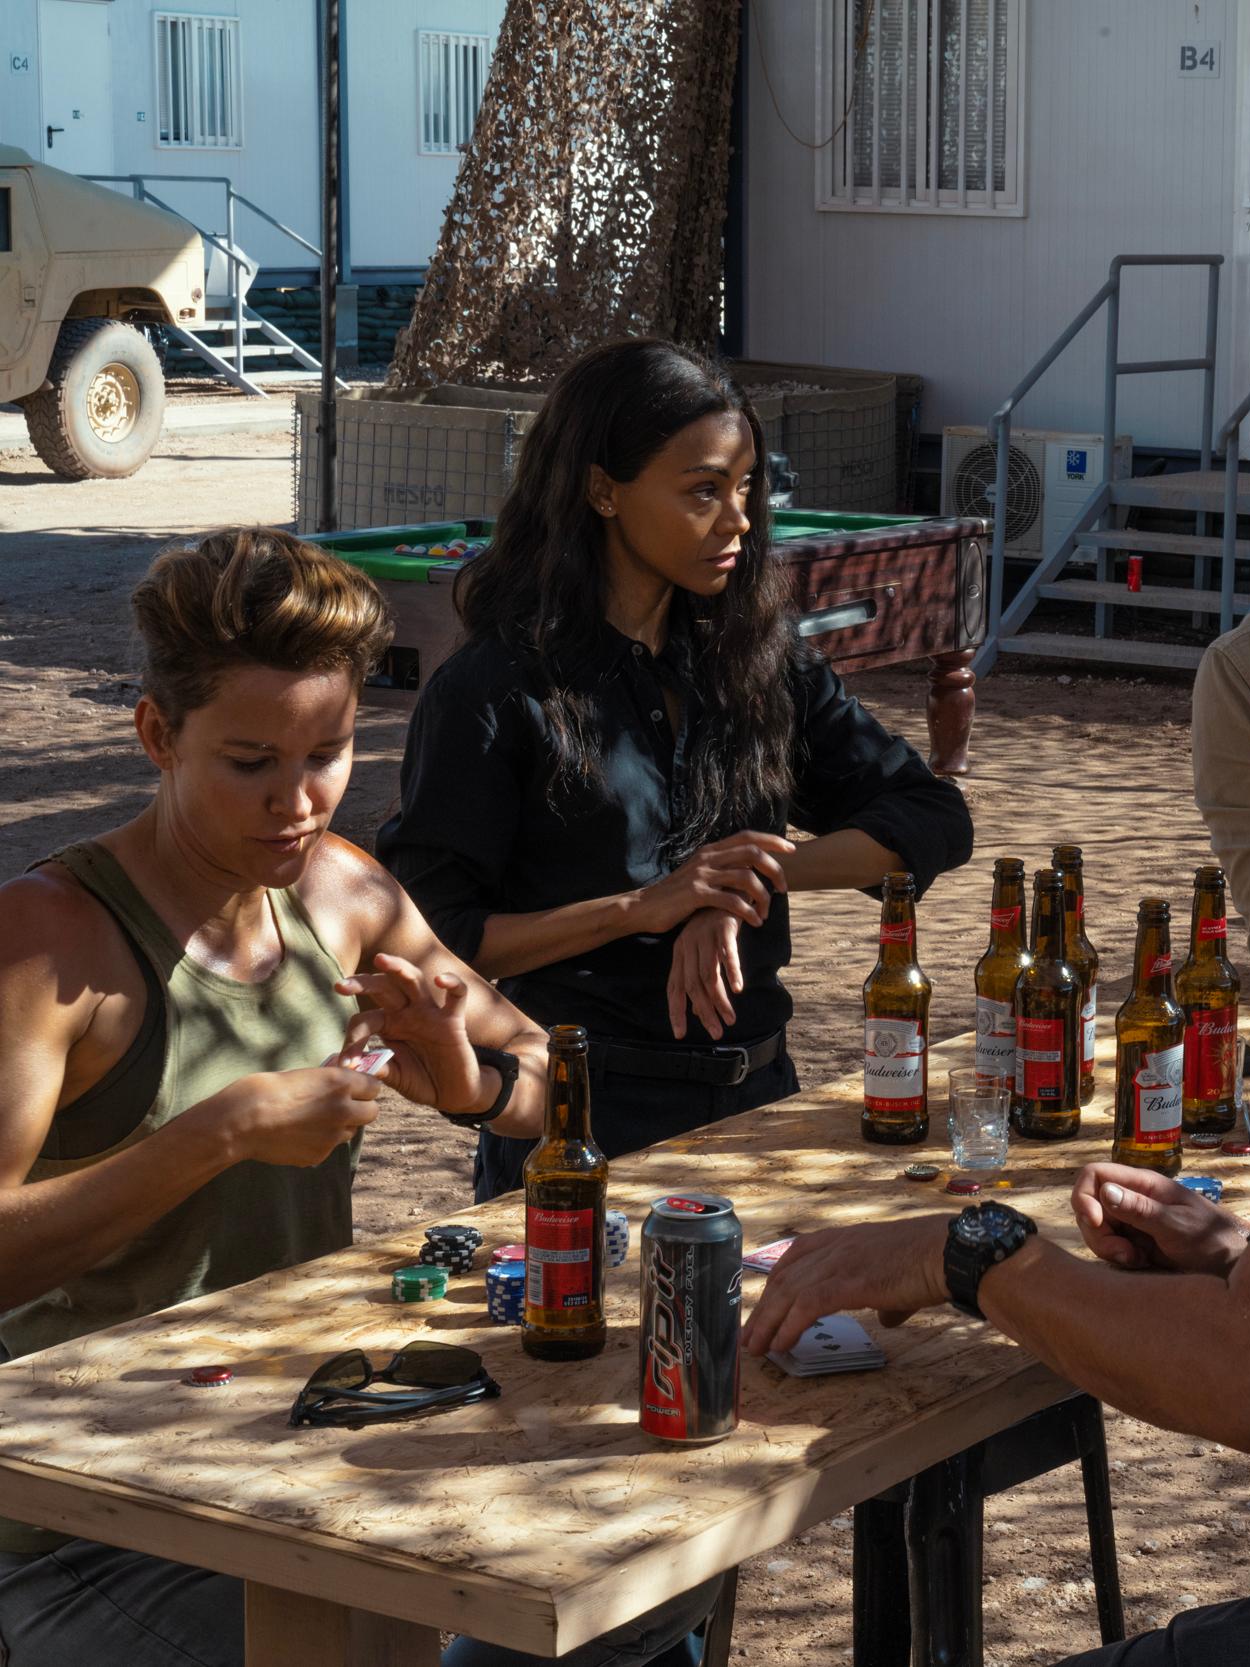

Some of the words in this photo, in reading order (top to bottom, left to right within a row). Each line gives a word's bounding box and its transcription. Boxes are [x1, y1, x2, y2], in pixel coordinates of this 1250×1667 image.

[12, 56, 29, 71] C4
[1180, 46, 1215, 71] B4
[534, 1210, 580, 1224] Budweiser
[684, 1245, 695, 1291] FUEL
[683, 1294, 695, 1367] ENERGY
